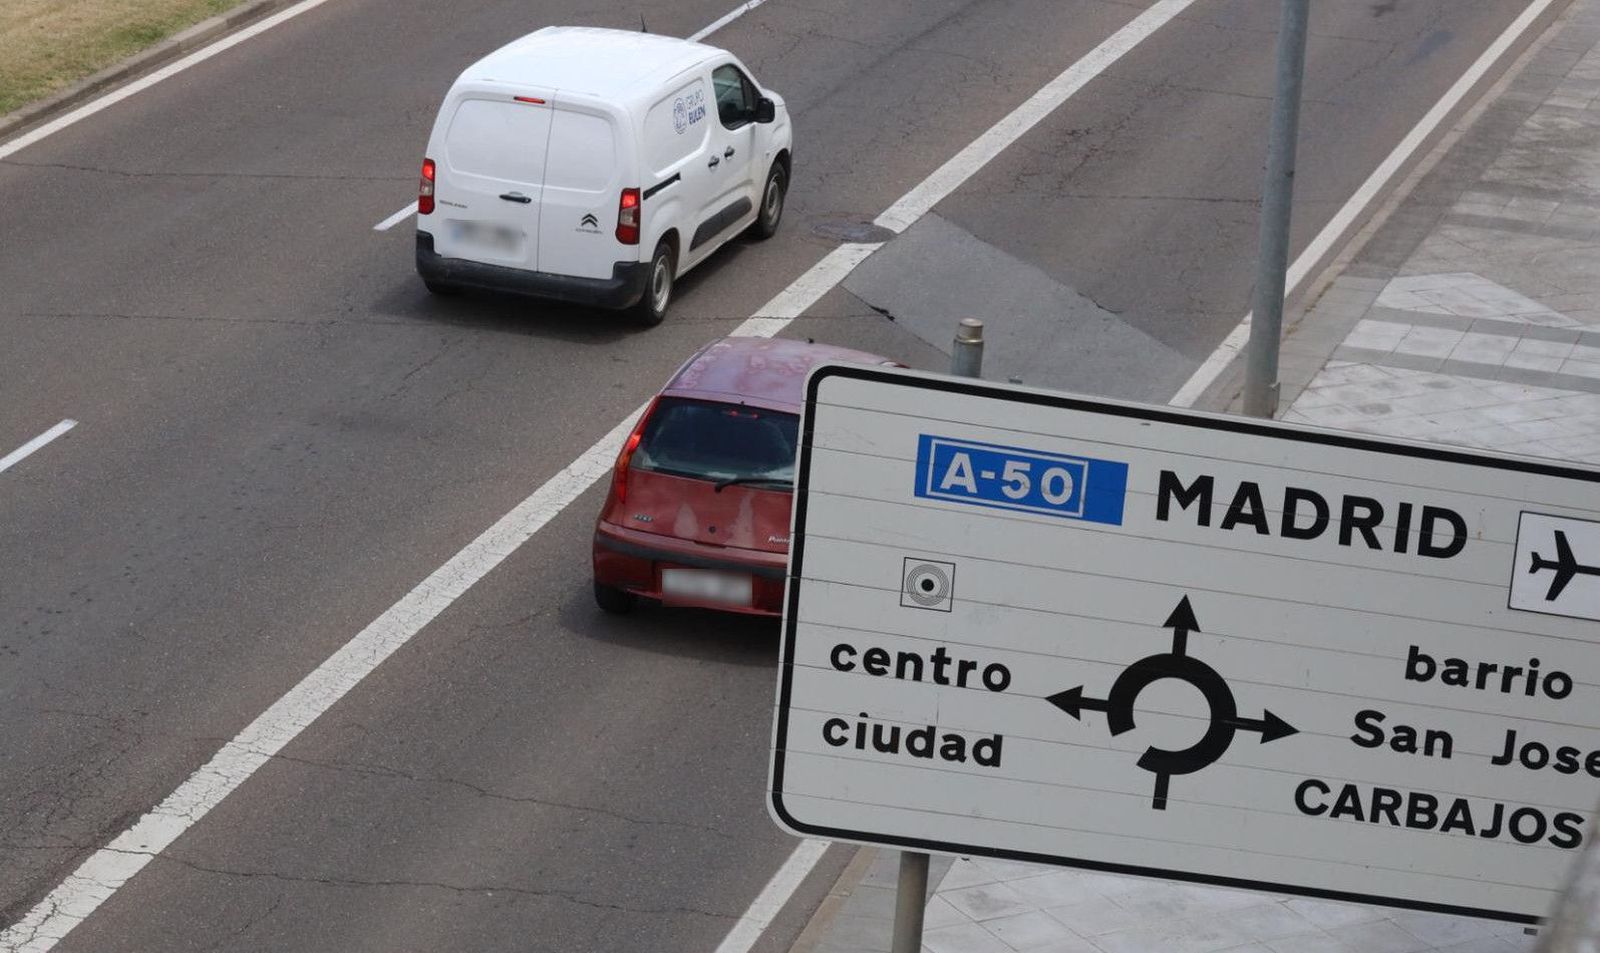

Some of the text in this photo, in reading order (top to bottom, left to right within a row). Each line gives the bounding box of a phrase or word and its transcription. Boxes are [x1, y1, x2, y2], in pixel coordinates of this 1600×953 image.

[940, 452, 1074, 506] A-50
[1156, 470, 1468, 559] MADRID
[830, 643, 1012, 693] centro
[1404, 645, 1574, 700] barrio
[822, 712, 1004, 768] ciudad
[1350, 709, 1600, 779] San Jose
[1294, 778, 1586, 850] CARBAJOS
